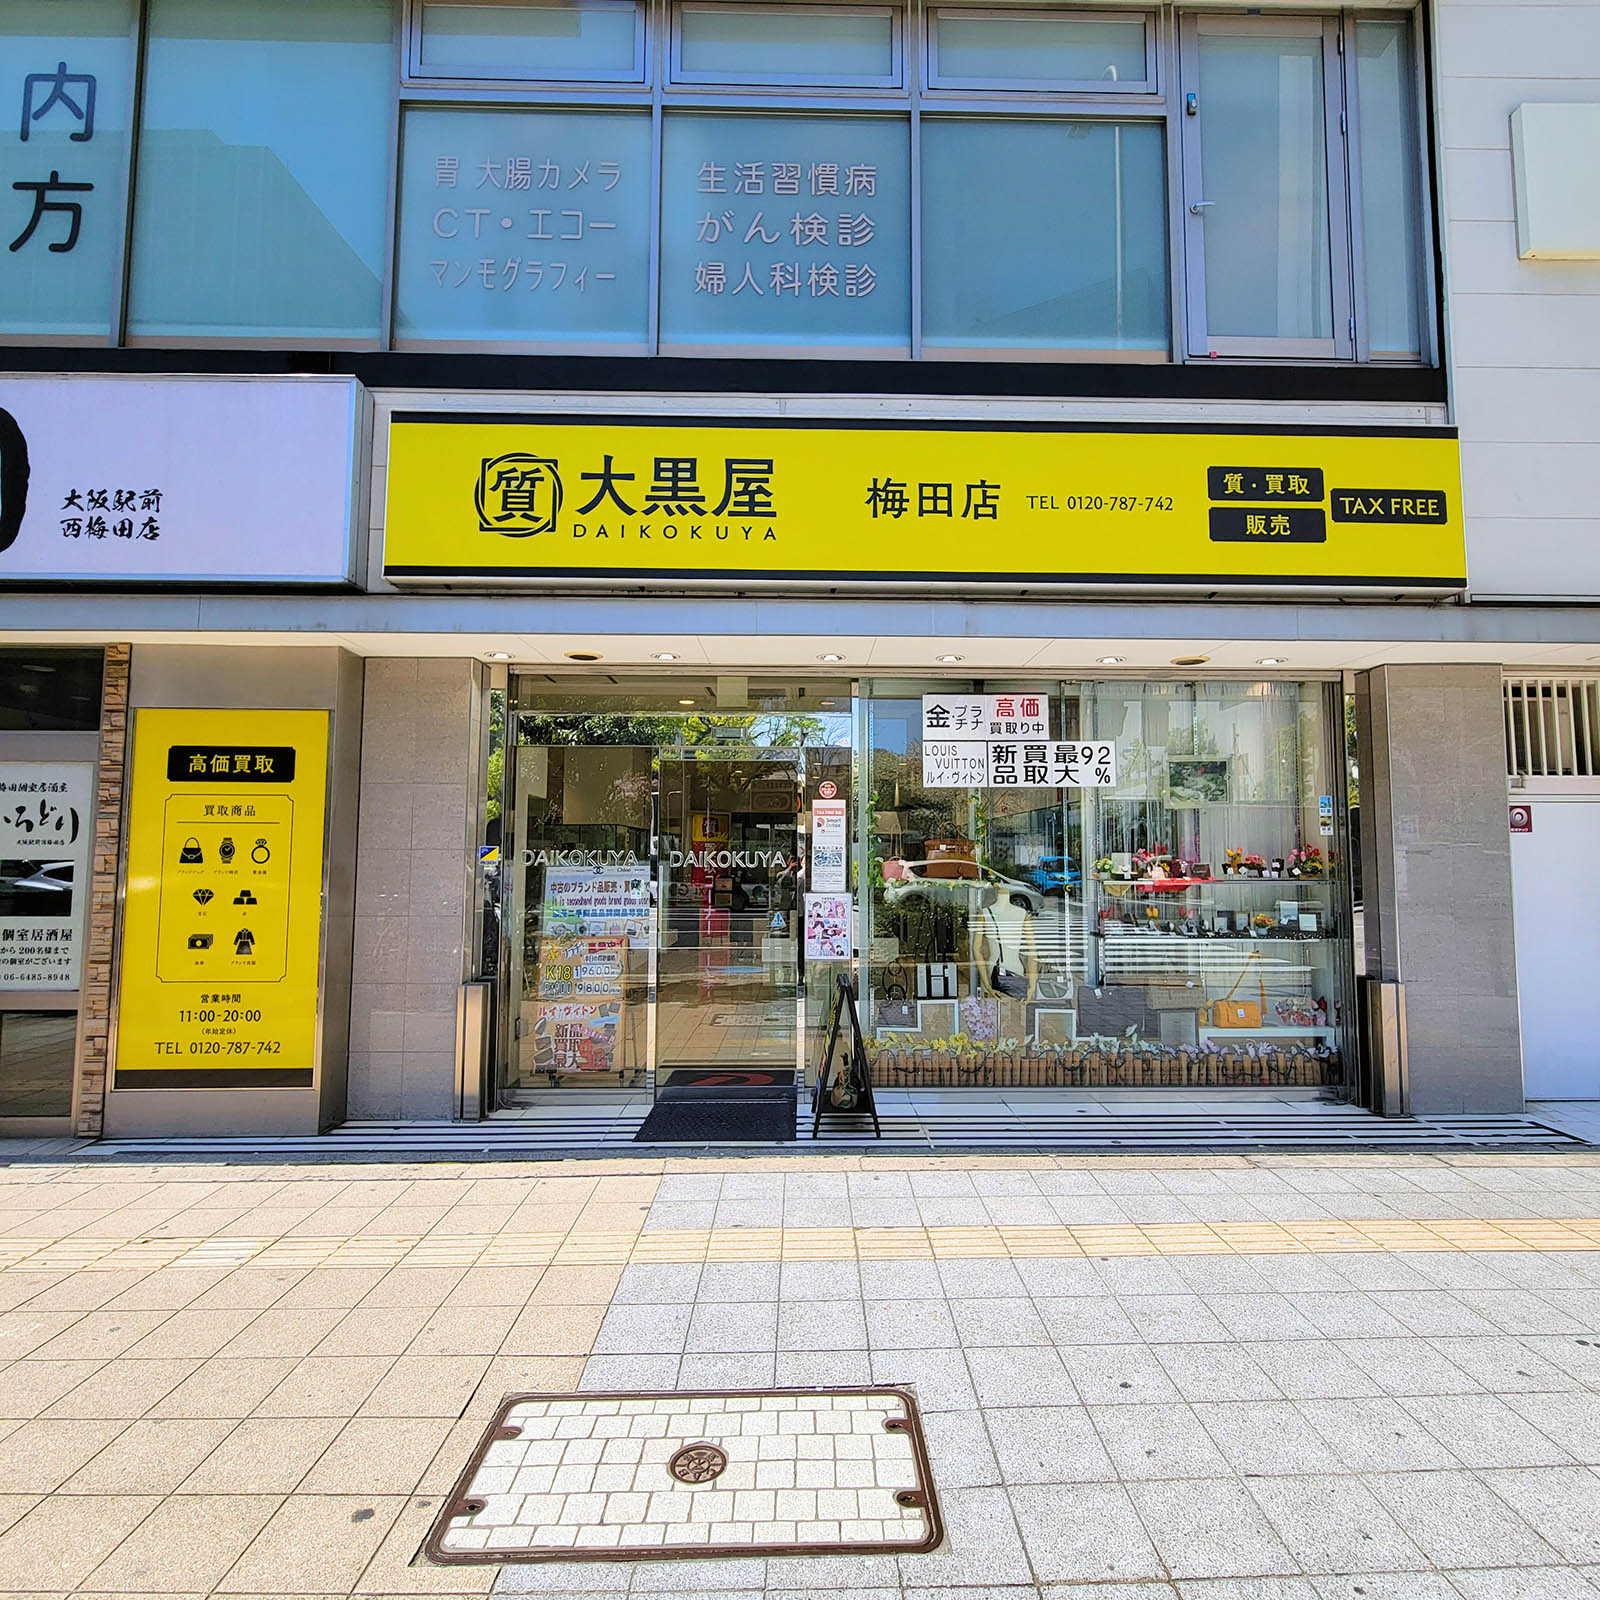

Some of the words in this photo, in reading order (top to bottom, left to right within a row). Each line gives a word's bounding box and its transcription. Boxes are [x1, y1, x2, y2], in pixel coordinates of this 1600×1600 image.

[20, 62, 97, 142] 内
[434, 155, 460, 189] 胃
[474, 156, 623, 191] 大腸カメラ
[696, 160, 878, 198] 生活習慣病
[9, 170, 94, 252] 方
[432, 207, 618, 241] CT・エコー
[695, 210, 877, 248] がん検診
[429, 258, 617, 293] マンモグラフィー
[694, 261, 878, 298] 婦人科検診
[489, 466, 545, 524] 質
[575, 454, 778, 519] 大黒屋
[865, 476, 1001, 521] 梅田店
[1026, 495, 1060, 511] TEL
[1066, 494, 1174, 512] 0120-787-742
[1222, 472, 1312, 496] 質・買取
[61, 488, 164, 513] 大阪駅前
[1339, 496, 1385, 516] TAX
[1390, 497, 1440, 517] FREE
[59, 516, 161, 541] 西梅田店
[572, 523, 778, 541] DAIKOKUYA
[1245, 513, 1292, 537] 販売
[995, 697, 1040, 718] 高価
[989, 721, 1045, 735] 買取り中
[925, 745, 958, 756] LOUIS
[1080, 746, 1111, 765] 92
[188, 753, 275, 774] 高価買取
[935, 758, 985, 770] VUITTON
[926, 771, 985, 784] ルイ・ヴィトン
[203, 804, 256, 817] 買取商品
[519, 849, 639, 867] DAIKOKUYA
[669, 850, 788, 868] DAIKOKUYA
[2, 928, 73, 942] 個室居酒屋
[0, 957, 73, 966] の個室がございます
[545, 964, 572, 981] K18
[200, 993, 241, 1004] 営業時間
[179, 1009, 262, 1022] 11:00-20:00
[538, 1005, 598, 1017] ルイ・ヴィトン
[154, 1041, 183, 1054] TEL
[189, 1041, 281, 1055] 0120-787-742
